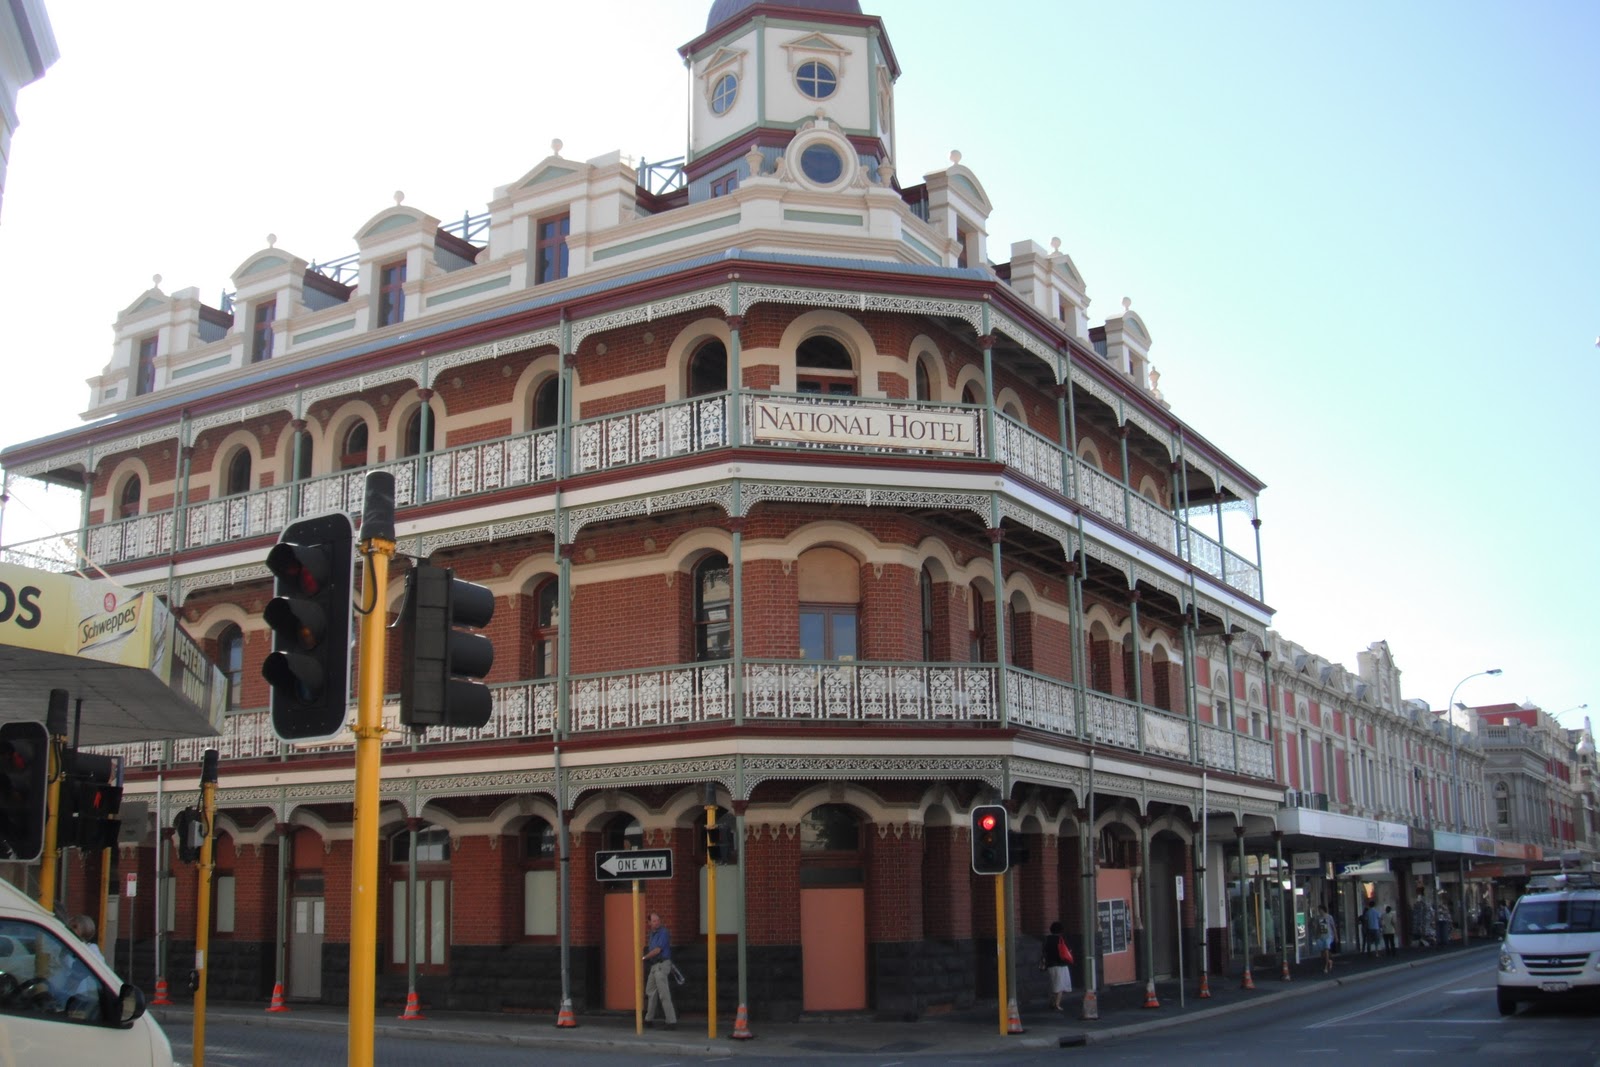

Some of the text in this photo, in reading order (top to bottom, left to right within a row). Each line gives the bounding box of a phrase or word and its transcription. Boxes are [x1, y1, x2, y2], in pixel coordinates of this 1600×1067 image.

[759, 405, 970, 442] NATIONAL HOTEL
[81, 605, 136, 644] Schweppes
[174, 626, 207, 683] WESTERN
[182, 667, 204, 711] UNION
[617, 858, 663, 871] ONE WAY
